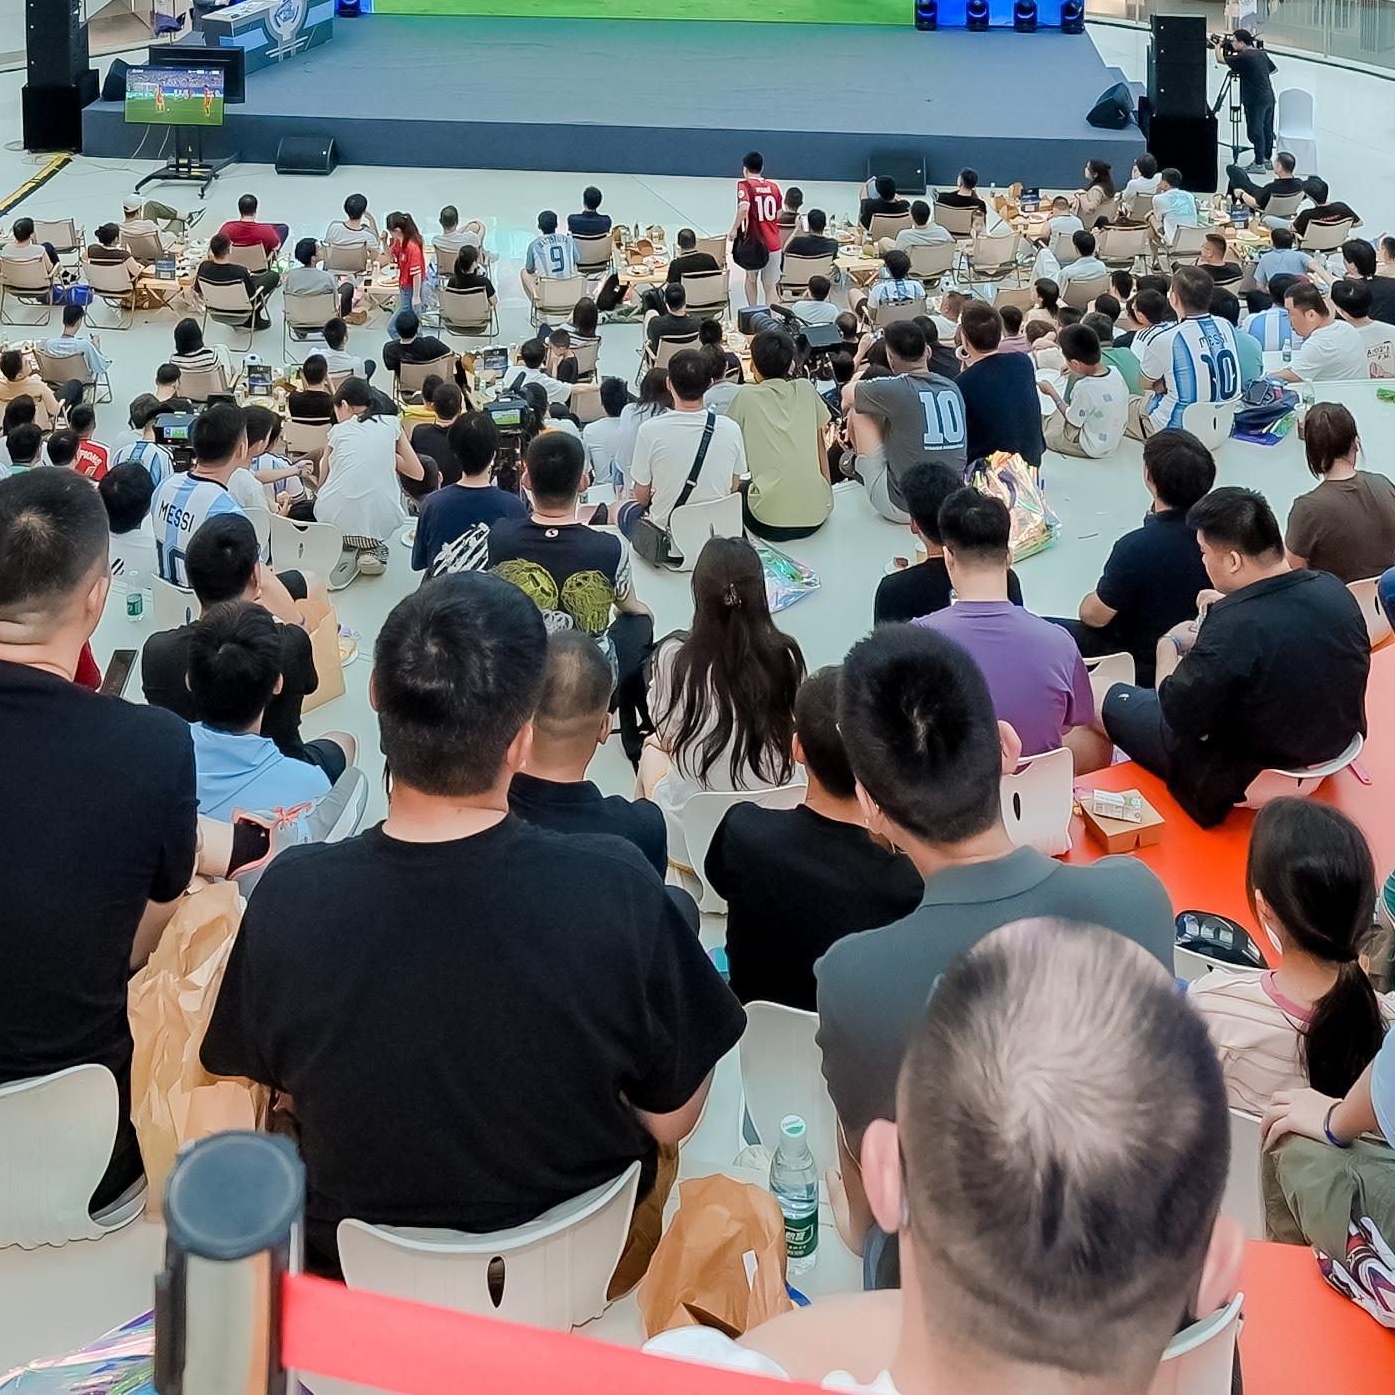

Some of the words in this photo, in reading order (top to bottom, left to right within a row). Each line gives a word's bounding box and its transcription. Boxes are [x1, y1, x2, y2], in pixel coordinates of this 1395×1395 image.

[755, 195, 776, 222] 10
[549, 245, 565, 273] 9
[1198, 331, 1229, 349] MESSI
[1200, 349, 1238, 403] 10
[918, 390, 965, 444] 10
[158, 499, 195, 533] MESSI
